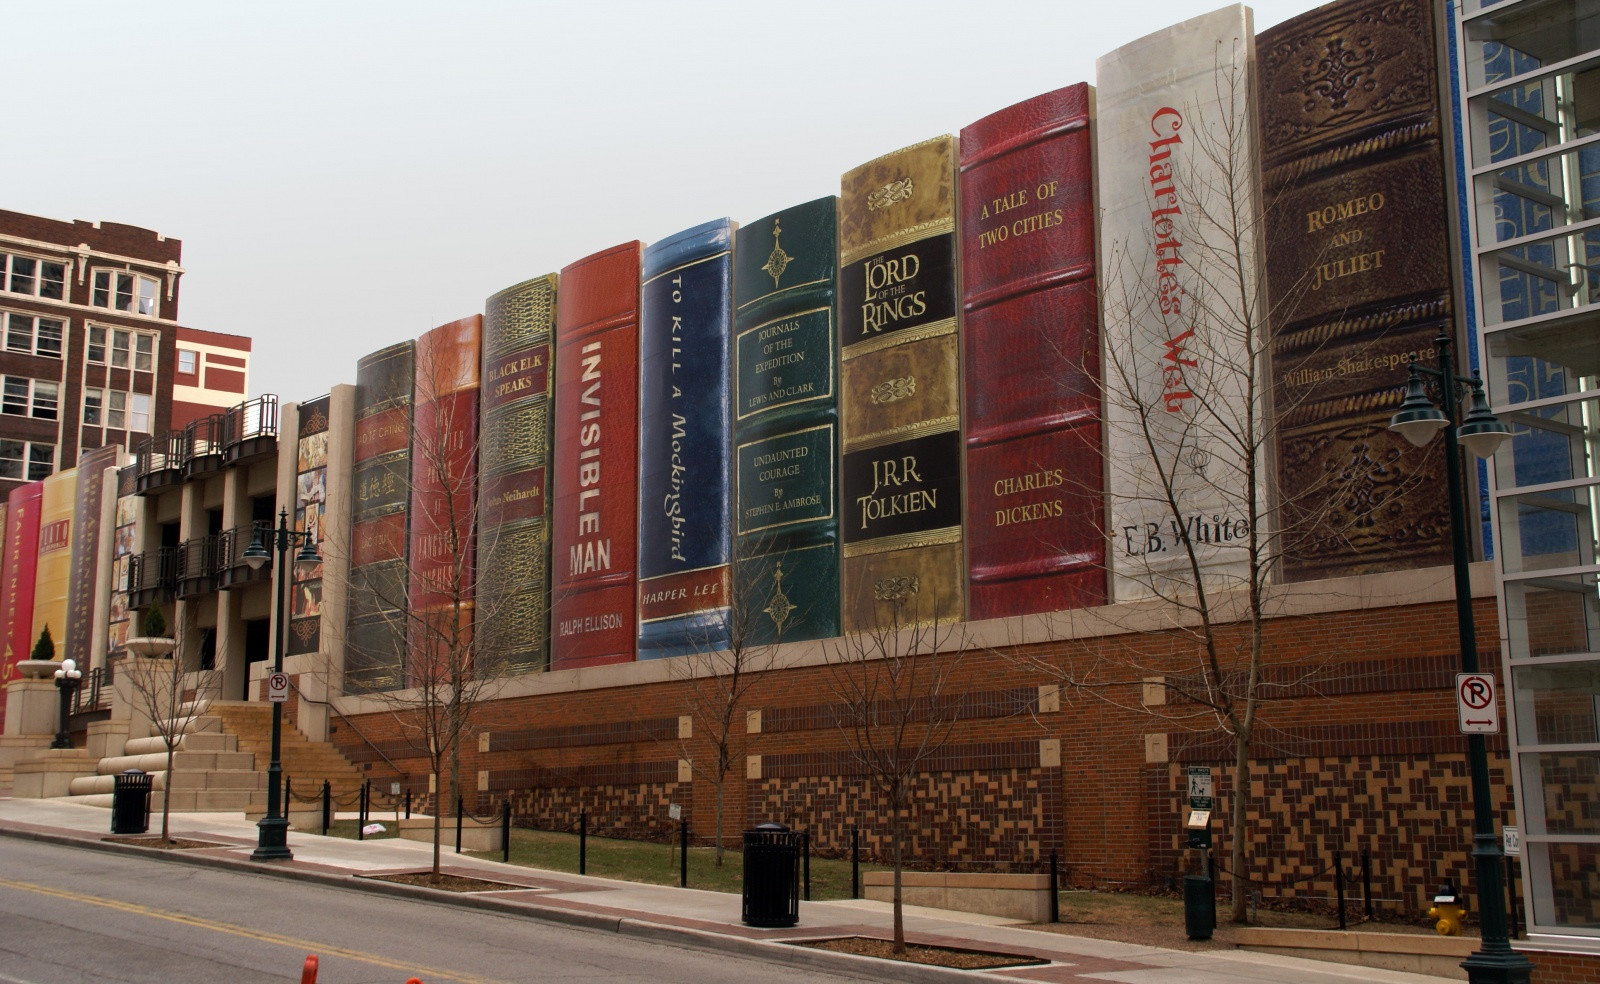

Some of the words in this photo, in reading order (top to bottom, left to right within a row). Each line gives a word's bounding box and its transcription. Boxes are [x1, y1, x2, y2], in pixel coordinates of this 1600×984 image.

[980, 204, 990, 220] A
[993, 189, 1028, 215] TALE
[1036, 180, 1059, 200] OF
[1148, 106, 1185, 315] Charlotte's
[1306, 192, 1386, 234] ROMEO
[978, 225, 1009, 249] TWO
[1013, 208, 1063, 237] CITIES
[1332, 229, 1363, 248] AND
[873, 255, 884, 265] THE
[1312, 250, 1386, 291] JULIET
[672, 274, 682, 304] TO
[864, 254, 920, 302] LORD
[878, 291, 888, 300] OF
[891, 284, 906, 296] THE
[862, 290, 927, 334] RINGS
[672, 316, 682, 375] KILL
[758, 320, 800, 344] JOURNALS
[763, 344, 774, 355] OF
[775, 338, 793, 351] THE
[488, 361, 518, 382] BLACK
[520, 354, 543, 371] ELK
[755, 351, 805, 374] EXPEDITION
[1162, 328, 1198, 413] Web
[1283, 368, 1333, 388] William
[1337, 347, 1435, 376] Shakespere
[495, 376, 532, 398] SPEAKS
[672, 385, 682, 398] A
[749, 396, 767, 408] LEWIS
[768, 389, 785, 401] AND
[786, 382, 814, 396] CLARK
[579, 341, 601, 536] INVISIBLE
[753, 446, 808, 467] UNDAUNTED
[664, 413, 687, 562] Mockingbird
[759, 464, 800, 482] COURAGE
[871, 455, 923, 495] J.R.R.
[994, 468, 1063, 497] CHARLES
[503, 486, 539, 502] Neihardt
[745, 503, 774, 518] STEPHEN
[782, 495, 822, 510] AMBROSE
[856, 488, 938, 530] TOLKIEN
[995, 500, 1063, 527] DICKENS
[1170, 514, 1250, 548] White
[570, 538, 611, 576] MAN
[642, 588, 687, 605] HARPER
[694, 582, 719, 597] LEE
[559, 618, 583, 636] RALPH
[585, 613, 623, 632] ELLISON
